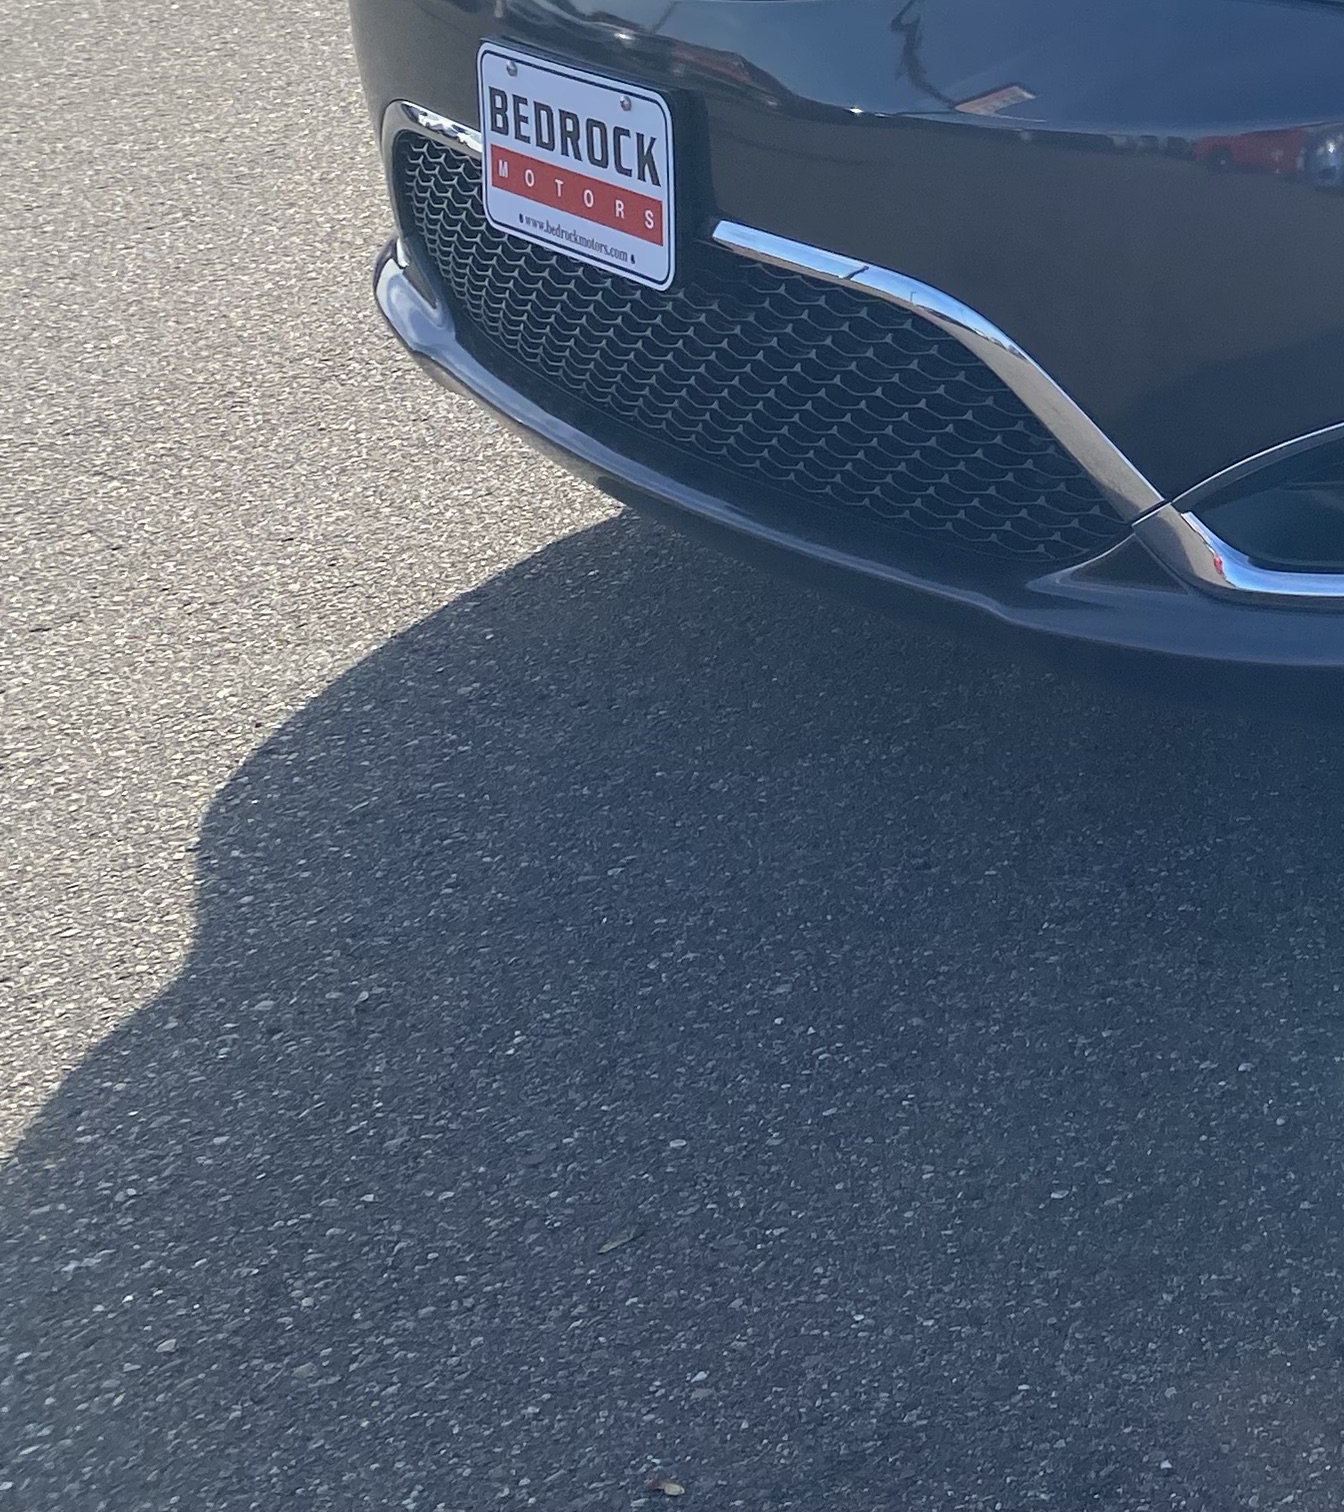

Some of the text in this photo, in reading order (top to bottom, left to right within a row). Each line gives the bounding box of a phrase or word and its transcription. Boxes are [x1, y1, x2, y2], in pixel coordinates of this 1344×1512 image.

[488, 86, 661, 188] BEDROCK
[498, 159, 654, 230] MOTORS
[525, 215, 629, 263] www.bedrockmotors.com
